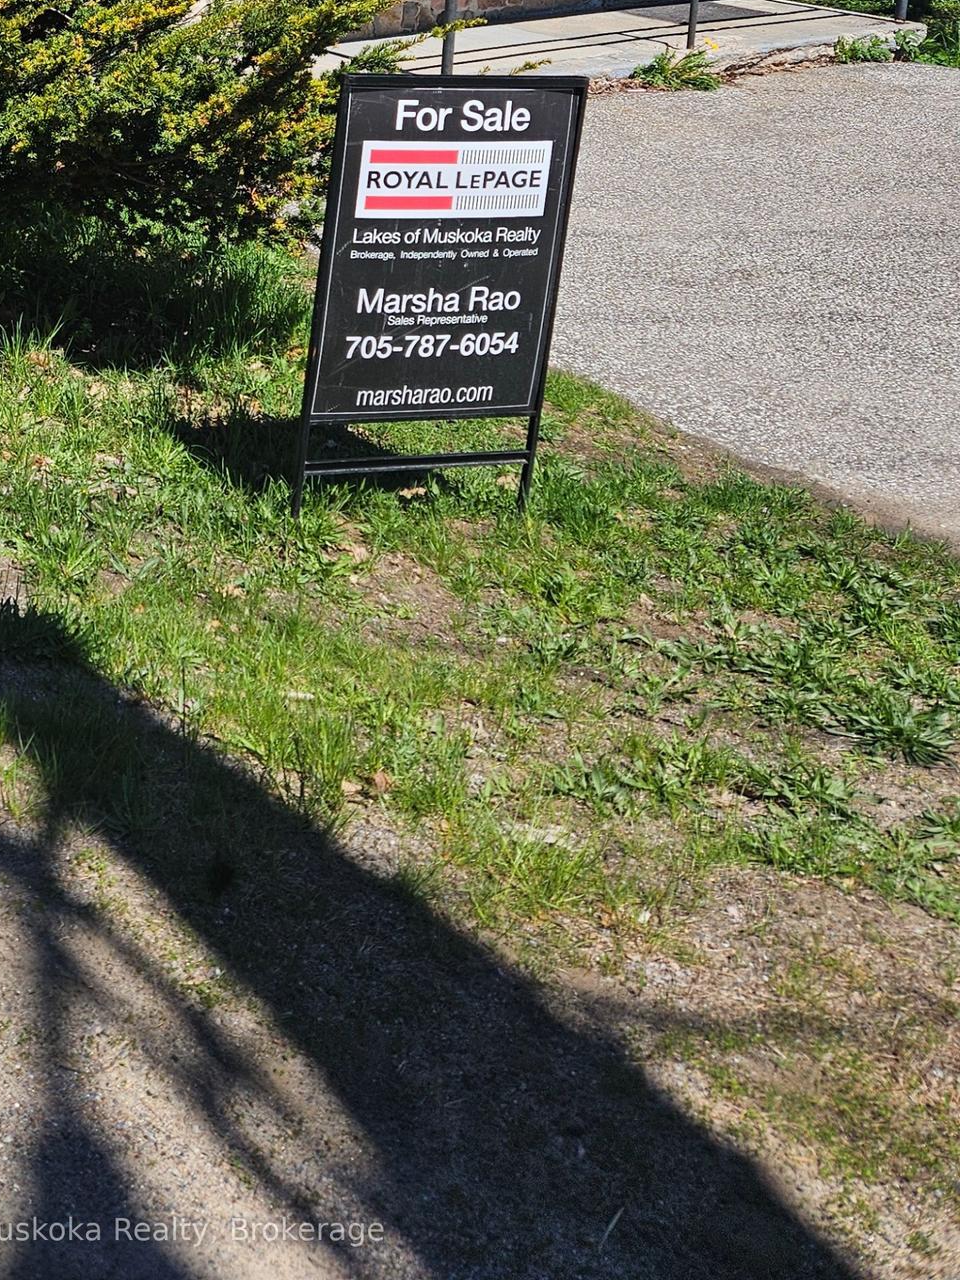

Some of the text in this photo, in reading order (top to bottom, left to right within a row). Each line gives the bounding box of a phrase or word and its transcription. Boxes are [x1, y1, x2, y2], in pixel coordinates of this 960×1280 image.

[395, 99, 531, 132] For Sale
[366, 170, 449, 189] ROYAL
[352, 226, 541, 244] Lakes of Muskoka Realty
[350, 248, 538, 260] Brokerage, Independently Owned & Operated
[356, 286, 521, 314] Marsha Rao
[387, 314, 488, 326] Sales Representative
[345, 331, 519, 359] 705-787-6054
[355, 385, 493, 406] marsharao.com
